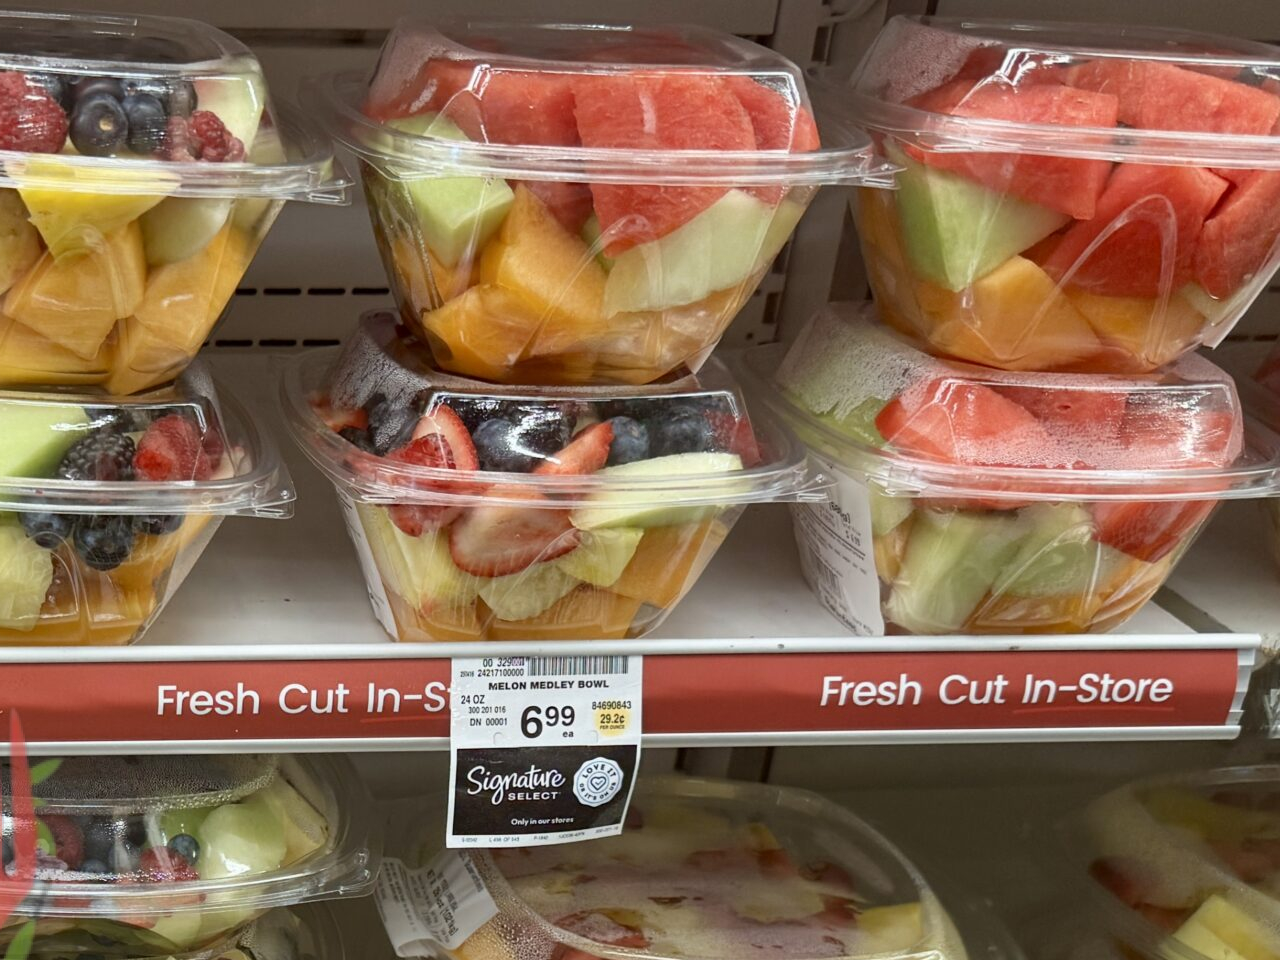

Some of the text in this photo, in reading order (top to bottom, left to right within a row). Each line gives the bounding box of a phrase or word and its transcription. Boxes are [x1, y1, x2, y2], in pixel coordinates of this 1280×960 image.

[477, 669, 524, 677] 24217100000
[488, 680, 609, 691] MELON MEDLEY BOWL
[820, 673, 1174, 706] Fresh Cut In-Store
[157, 681, 451, 716] Fresh Cut In-S
[461, 695, 485, 704] 24 OZ
[592, 701, 631, 710] 84690843
[470, 718, 508, 726] DN 00001
[583, 763, 616, 778] LOVE IT
[467, 765, 566, 805] Signature
[508, 792, 558, 800] SELECT
[511, 818, 528, 827] Only
[551, 817, 574, 825] stores
